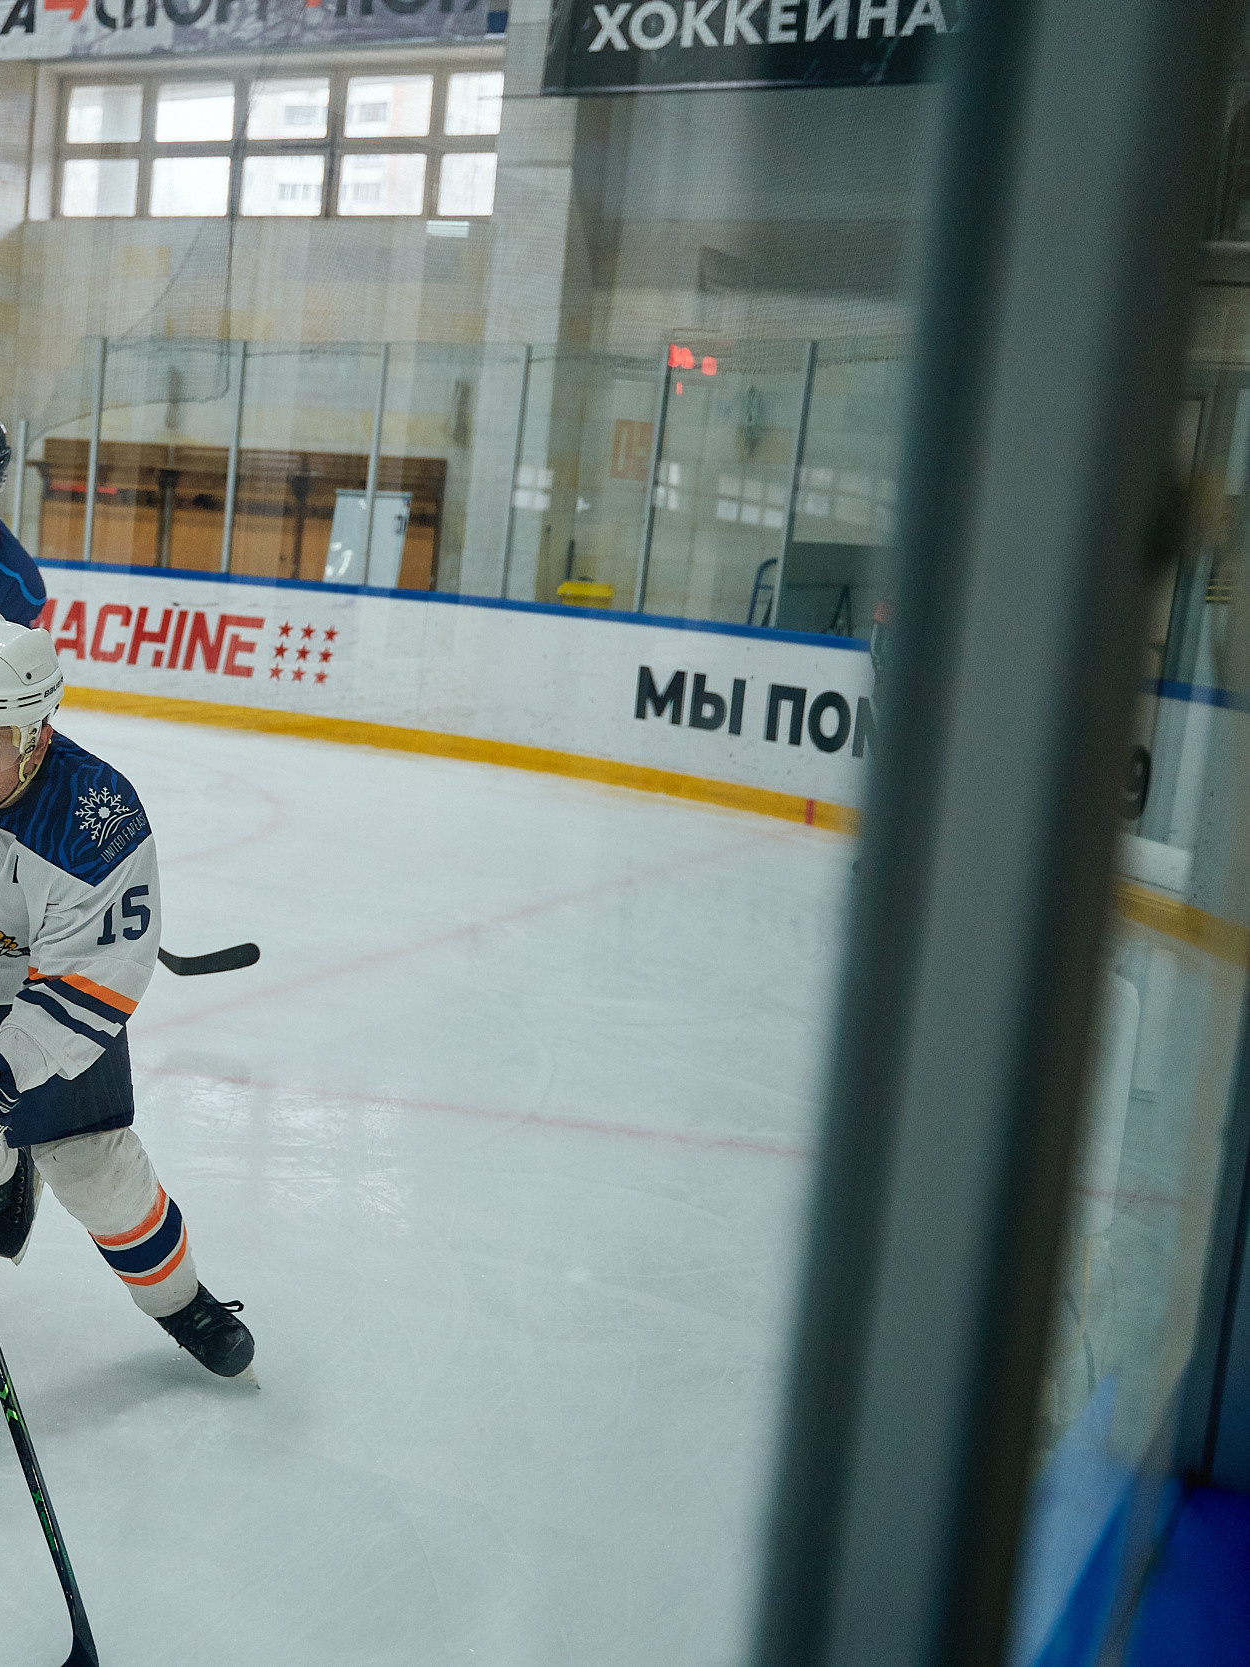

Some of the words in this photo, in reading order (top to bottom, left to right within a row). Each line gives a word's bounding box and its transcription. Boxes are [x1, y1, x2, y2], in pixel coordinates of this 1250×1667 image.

[635, 665, 747, 736] МЫ
[100, 834, 127, 863] UNITED
[96, 884, 151, 946] 15
